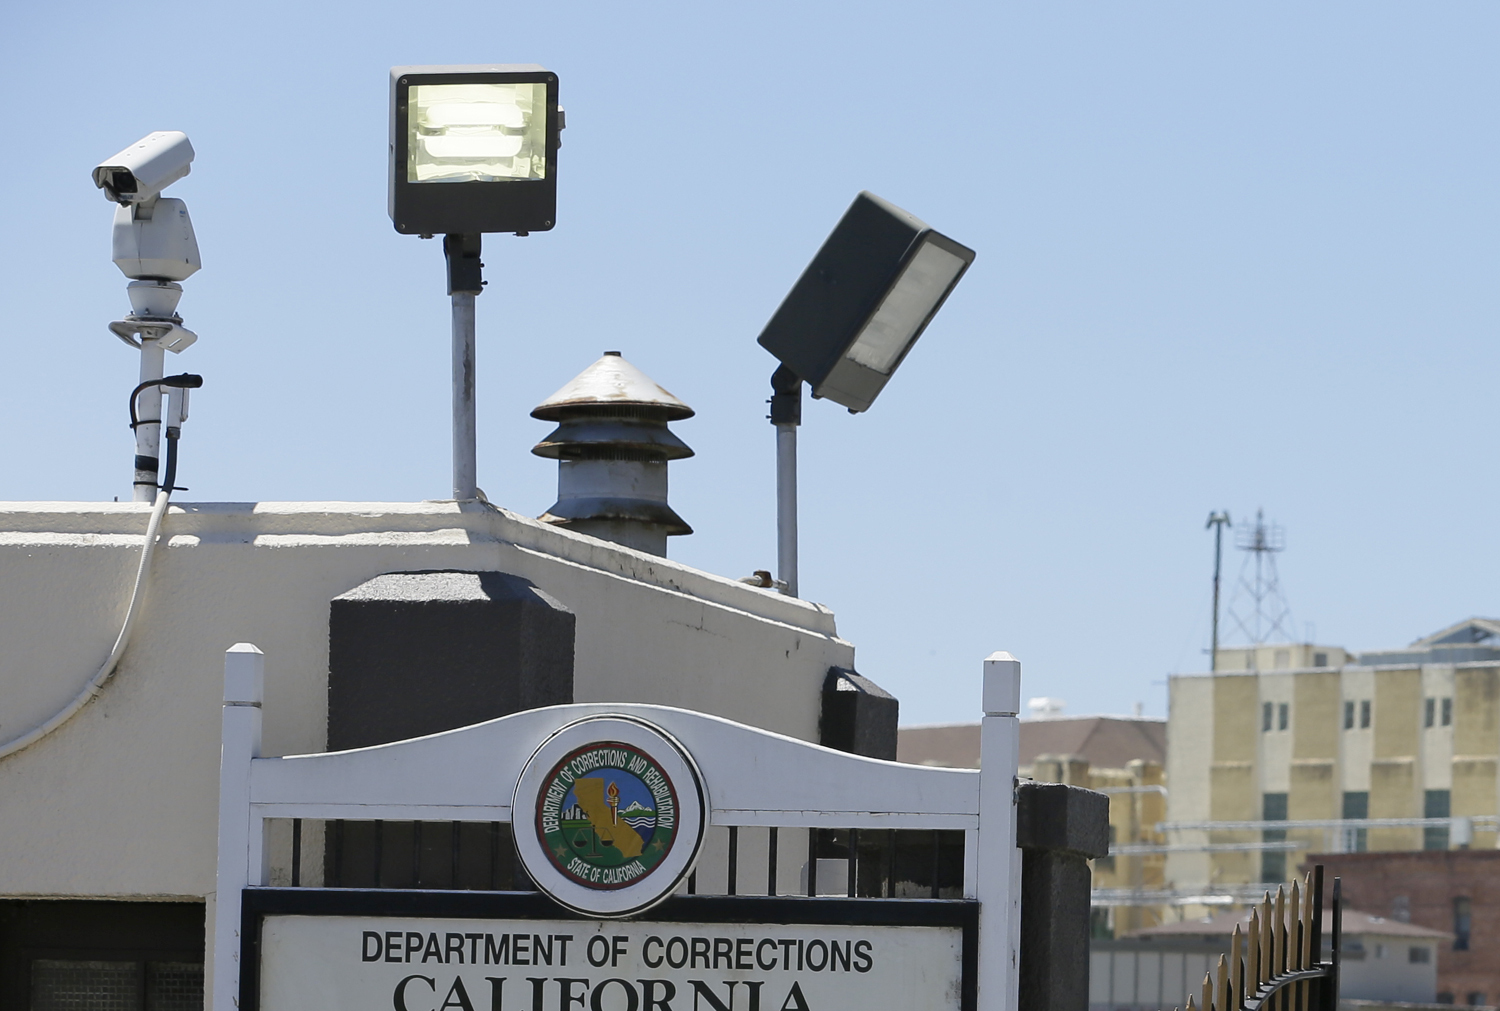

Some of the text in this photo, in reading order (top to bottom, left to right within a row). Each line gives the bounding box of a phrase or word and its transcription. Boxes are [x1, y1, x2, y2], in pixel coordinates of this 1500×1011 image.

[542, 749, 674, 834] DEPARTMENT OF CORRECTIONS AND REHABILITATION
[567, 857, 647, 884] STATE OF CALIFORNIA
[362, 931, 872, 973] DEPARTMENT OF CORRECTIONS
